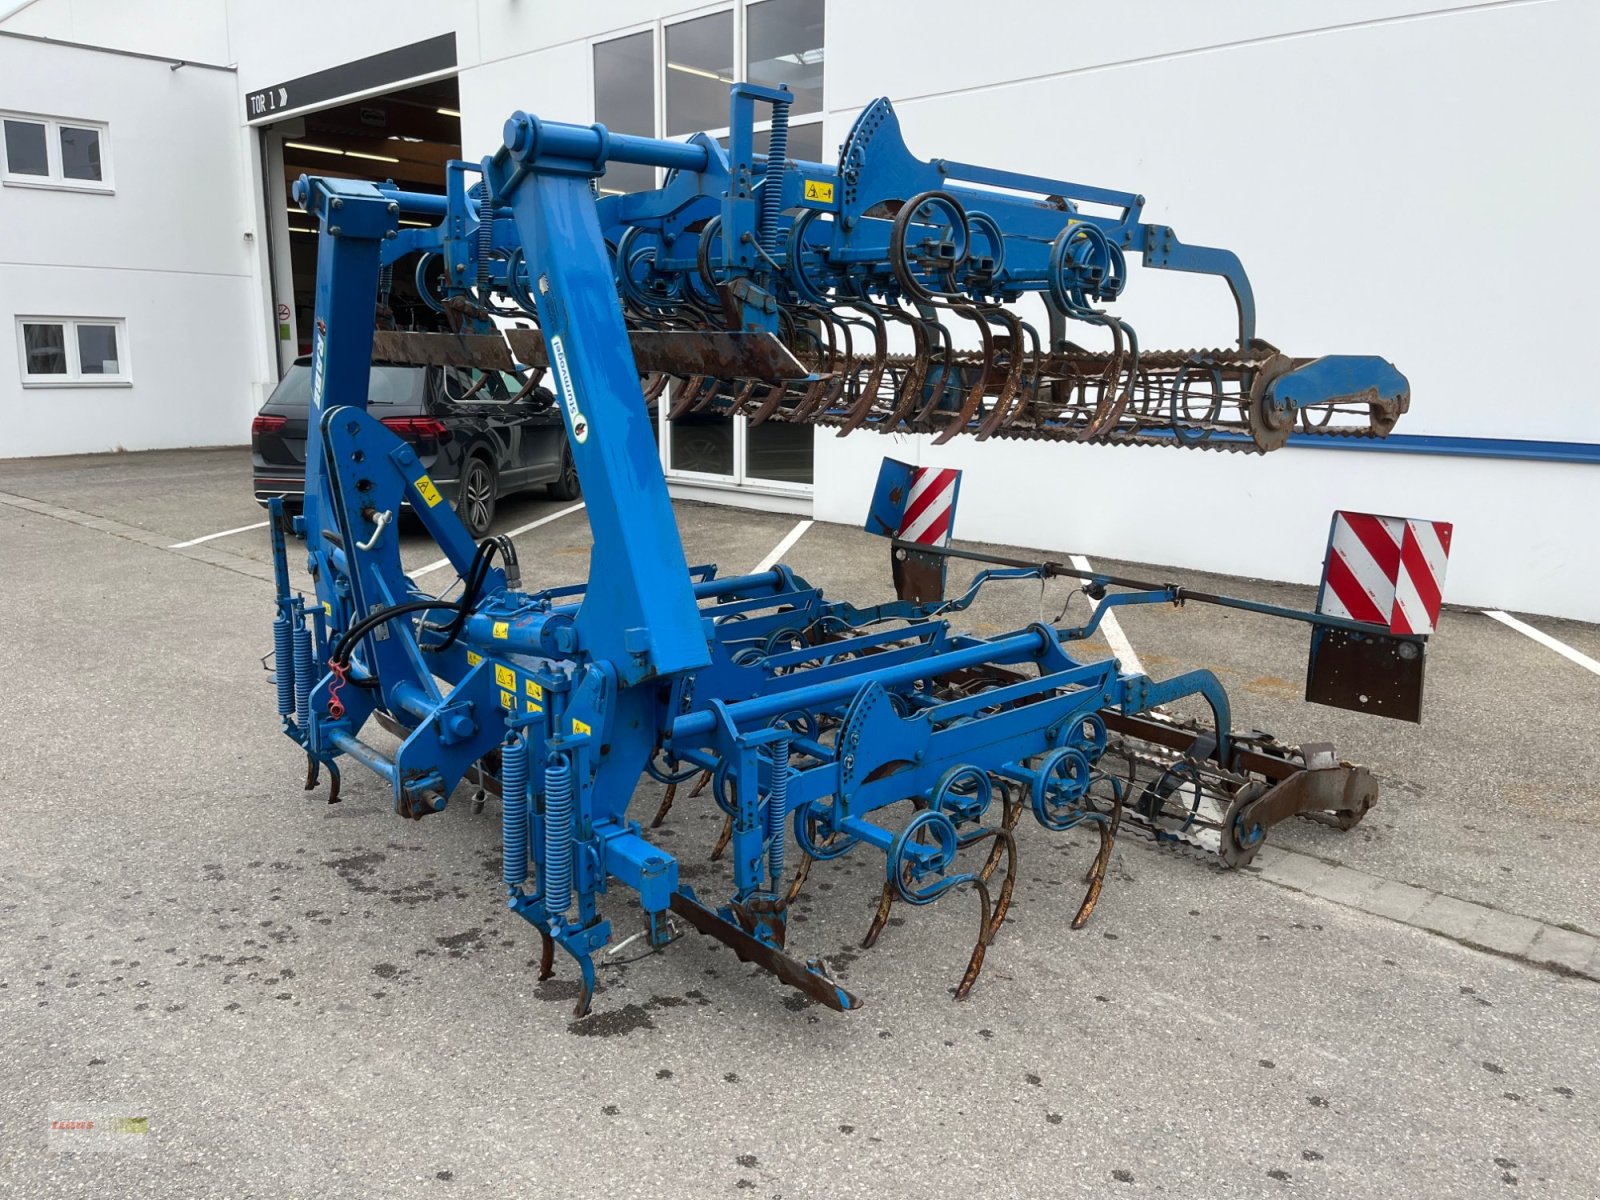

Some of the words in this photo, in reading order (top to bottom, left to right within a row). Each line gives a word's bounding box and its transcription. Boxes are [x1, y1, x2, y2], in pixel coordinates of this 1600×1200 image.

[250, 93, 267, 115] TOR
[268, 91, 276, 110] 1
[552, 341, 576, 414] Sturmvogel
